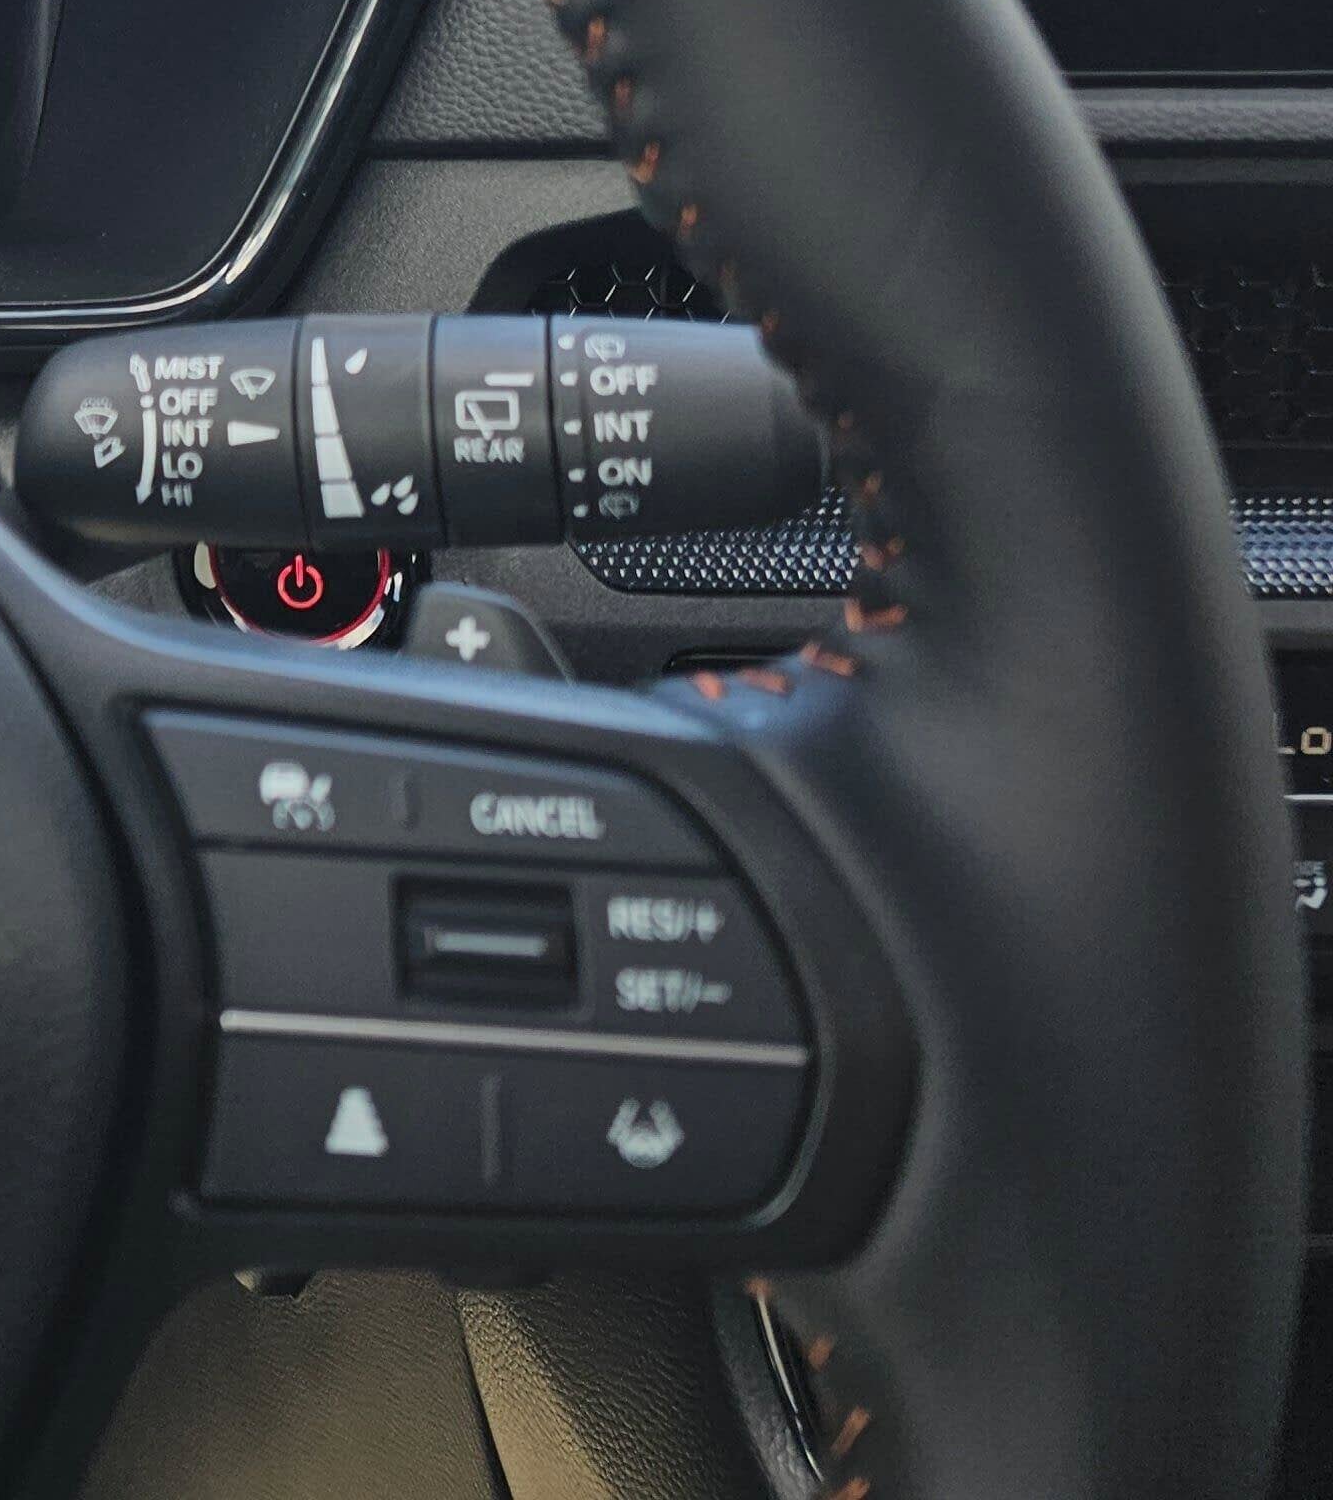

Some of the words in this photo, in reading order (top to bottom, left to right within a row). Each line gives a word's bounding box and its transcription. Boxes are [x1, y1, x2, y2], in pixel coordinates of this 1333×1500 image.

[155, 355, 224, 380] MIST
[590, 364, 658, 396] OFF
[159, 388, 218, 416] OFF
[162, 419, 213, 447] INT
[594, 410, 653, 443] INT
[453, 437, 525, 463] REAR
[162, 451, 203, 479] LO
[598, 457, 652, 486] ON
[161, 483, 193, 507] HI
[1277, 726, 1332, 755] O
[470, 792, 606, 839] CANCEL
